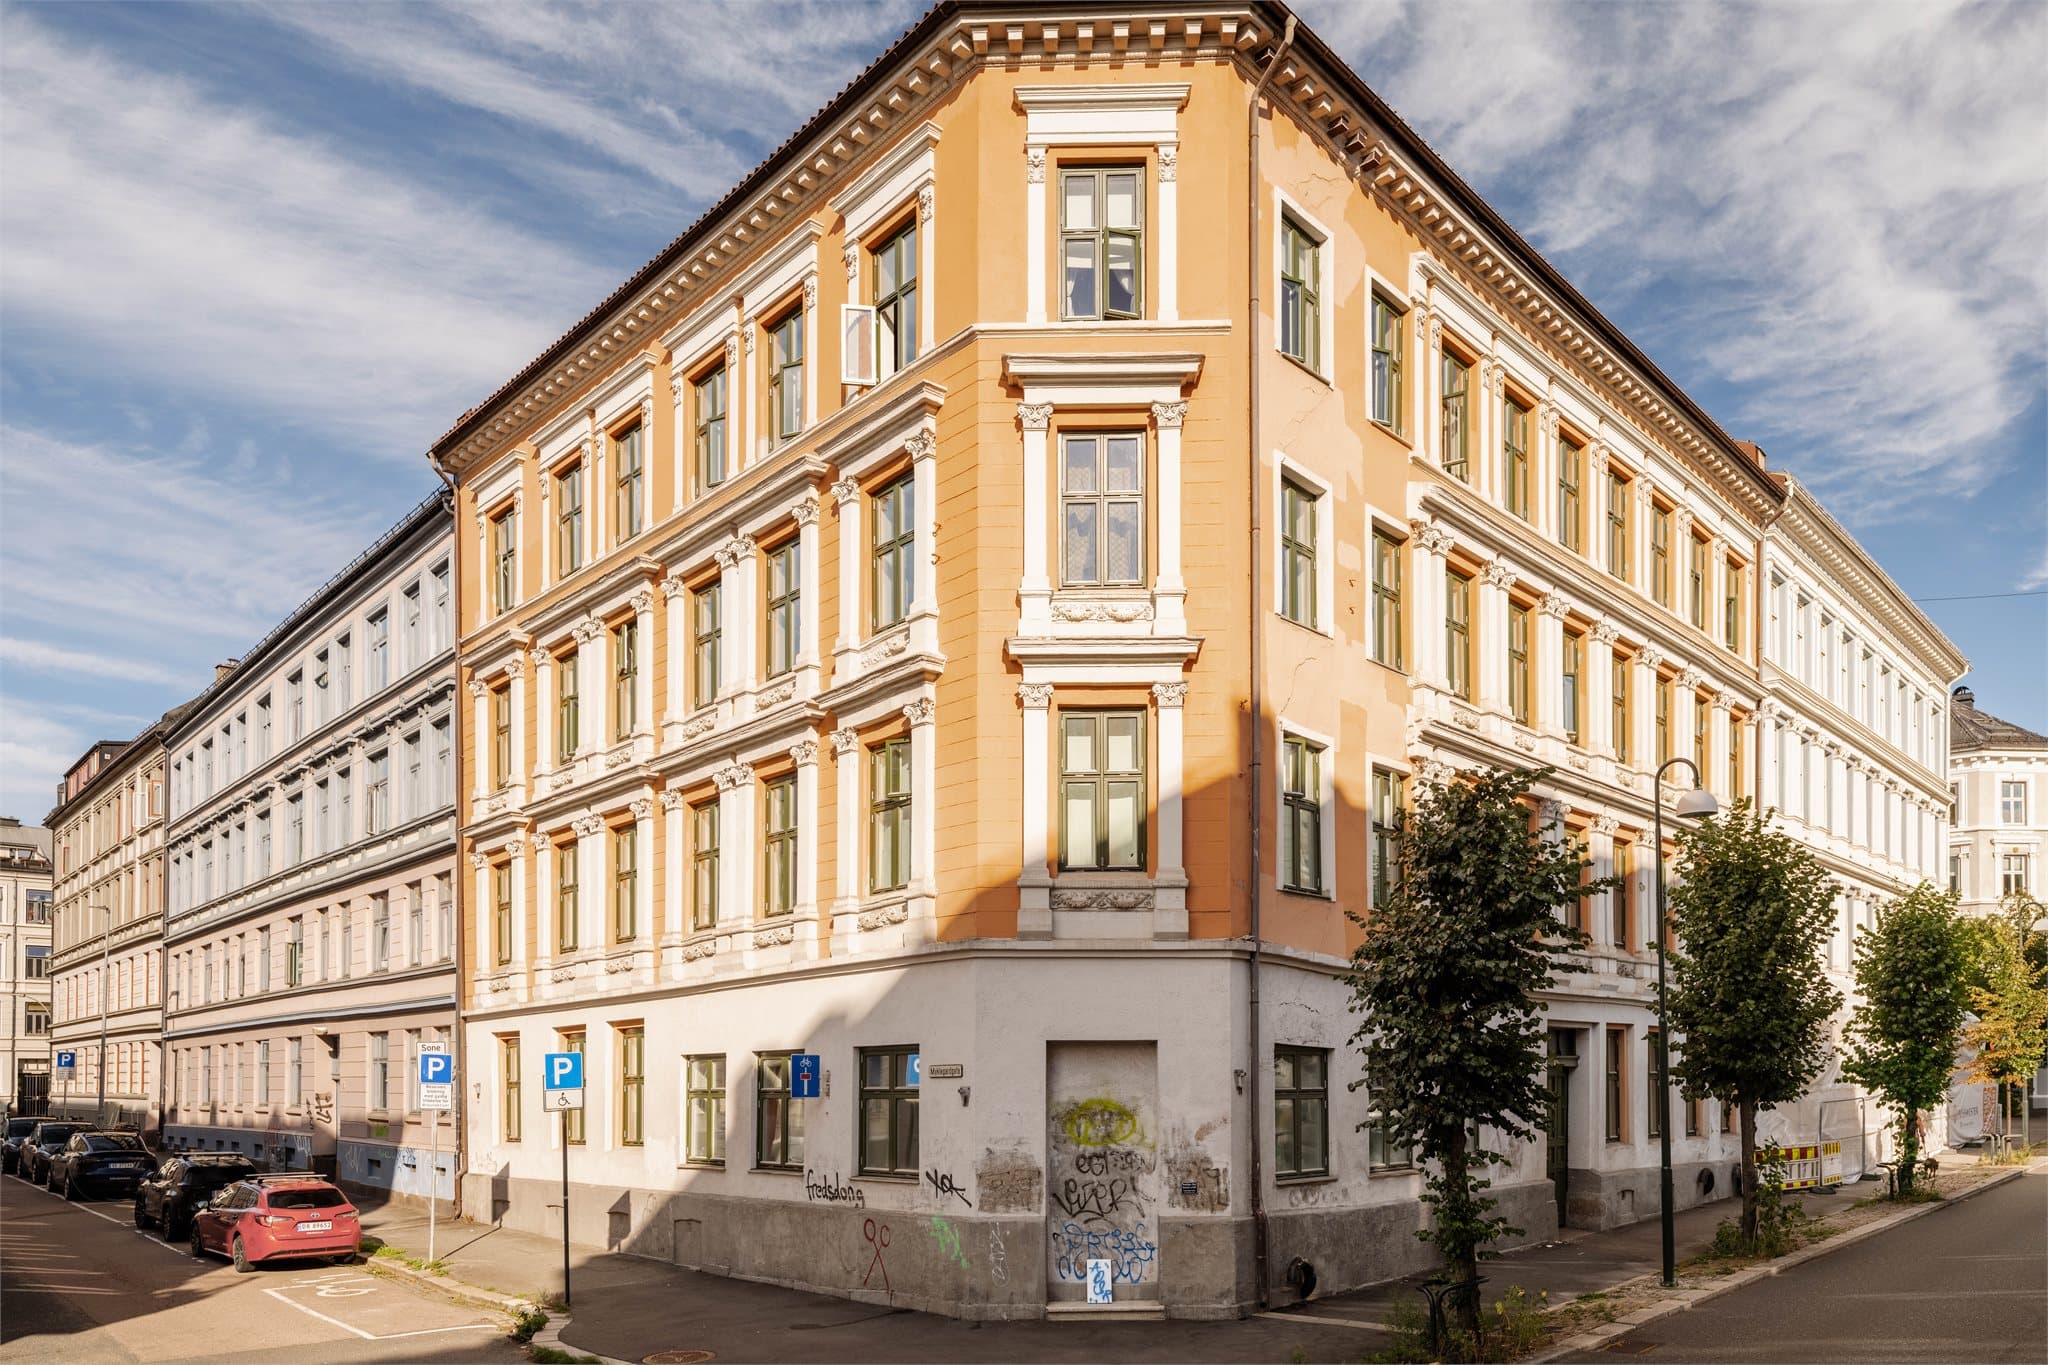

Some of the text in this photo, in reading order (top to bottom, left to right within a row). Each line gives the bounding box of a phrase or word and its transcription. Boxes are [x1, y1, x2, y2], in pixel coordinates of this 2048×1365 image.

[421, 1044, 441, 1052] Sone
[61, 1054, 71, 1066] P
[428, 1057, 445, 1080] P
[553, 1057, 573, 1086] P
